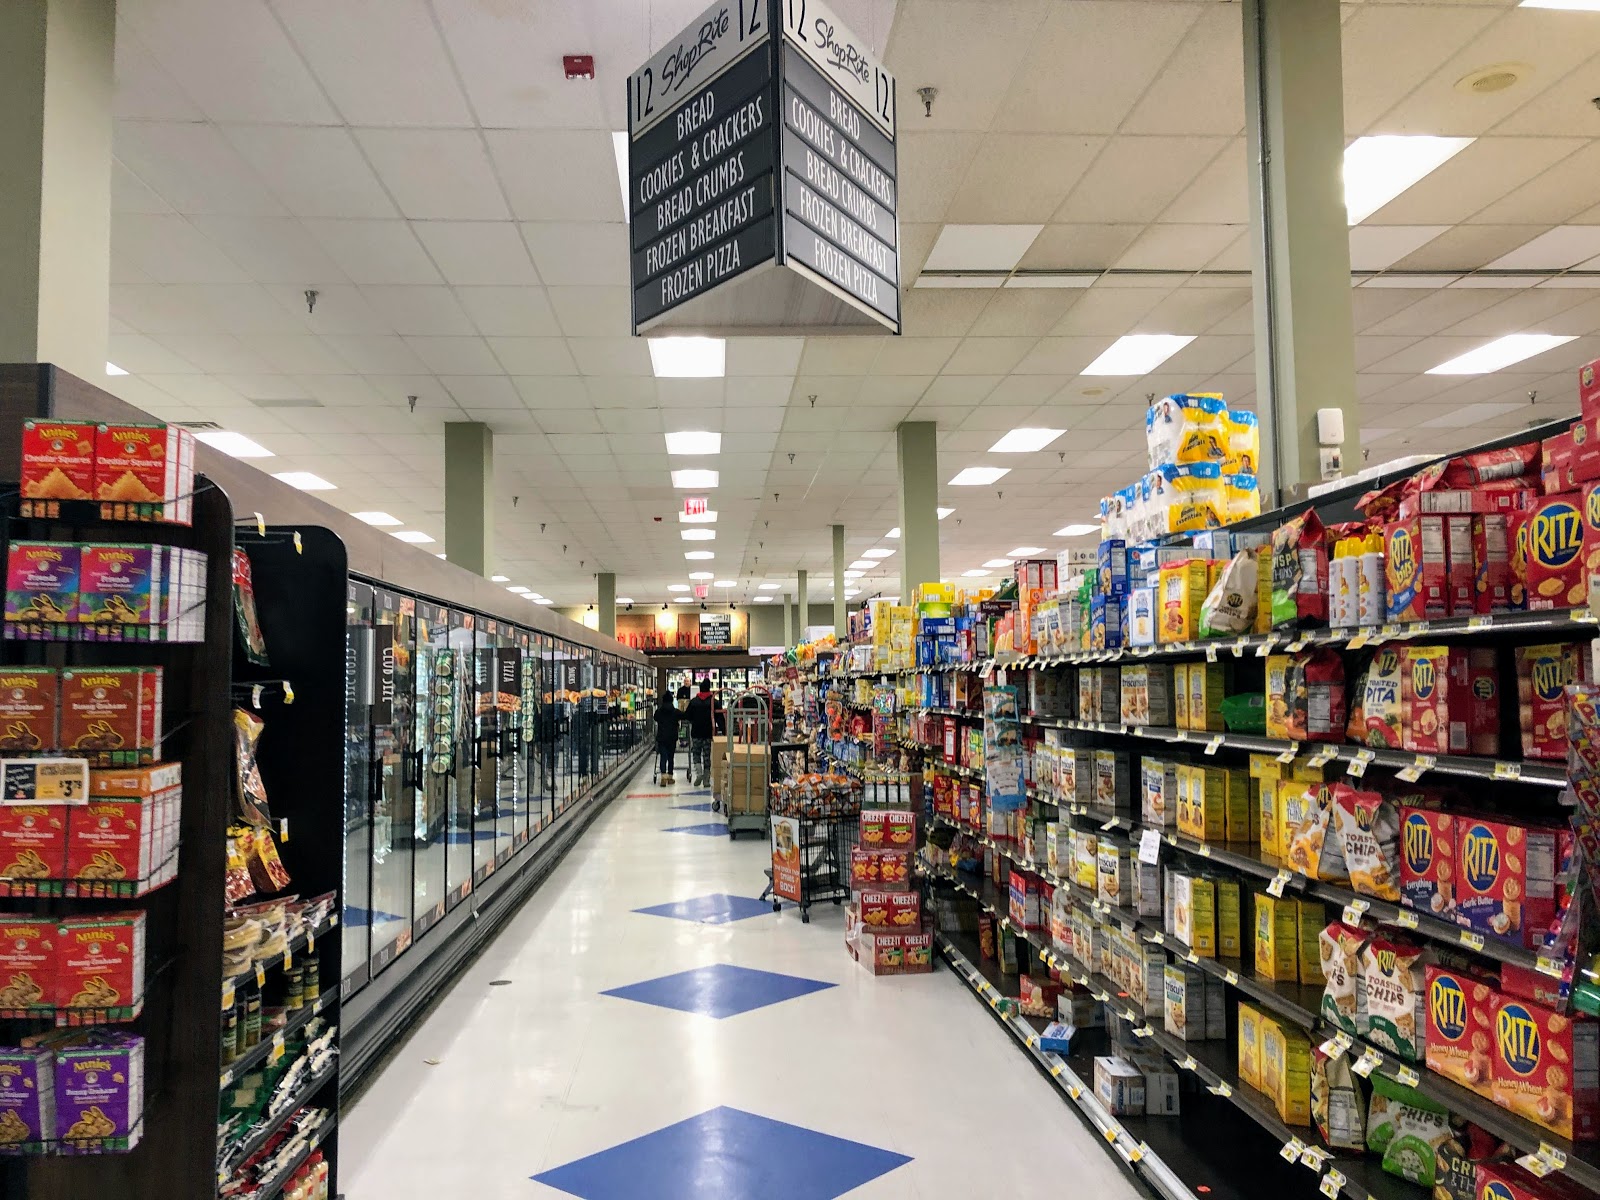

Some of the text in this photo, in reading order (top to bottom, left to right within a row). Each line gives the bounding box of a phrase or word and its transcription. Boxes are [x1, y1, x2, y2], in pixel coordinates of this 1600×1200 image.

[637, 0, 761, 122] 12 ShopRite 12
[788, 0, 890, 123] 12 ShopRite 12
[677, 91, 715, 141] BREAD
[829, 91, 860, 140] BREAD
[640, 95, 763, 203] COOKIES & CRACKERS
[792, 97, 891, 205] COOKIES & CRACKERS
[657, 152, 744, 231] BREAD CRUMBS
[806, 152, 877, 229] BREAD CRUMBS
[646, 187, 755, 275] FROZEN BREAKFAST
[800, 187, 887, 274] FROZEN BREAKFAST
[661, 240, 740, 305] FROZEN PIZZA
[815, 238, 878, 305] FROZEN PIZZA
[685, 499, 706, 515] EXIT
[1532, 511, 1582, 563] RITZ
[1392, 534, 1412, 568] RITZ
[617, 631, 666, 650] ROZEN
[503, 660, 515, 683] PIZZA
[1413, 663, 1434, 693] RITZ
[1535, 661, 1564, 695] RITZ
[1366, 687, 1396, 704] PITA
[1369, 680, 1398, 688] TOASTED
[862, 813, 885, 823] CHEEZ-IT
[889, 813, 913, 823] CHEEZ-IT
[1346, 833, 1375, 843] TOAST
[1346, 842, 1376, 856] CHIP
[1404, 821, 1431, 865] RITZ
[1464, 832, 1498, 881] RITZ
[1406, 878, 1433, 891] Everything
[863, 894, 887, 904] CHEEZ-IT
[892, 895, 917, 905] CHEEZ-IT
[1463, 896, 1494, 908] Garlic Butter
[877, 936, 901, 946] CHEEZ-IT
[905, 935, 929, 945] CHEEZ-IT
[1377, 949, 1396, 973] RITZ
[1366, 984, 1405, 1006] CHIPS
[1431, 981, 1465, 1029] RITZ
[1498, 1010, 1538, 1062] RITZ
[1430, 1043, 1469, 1059] Honey Wheat
[1498, 1077, 1543, 1096] Honey Wheat
[1400, 1105, 1444, 1128] CHIPS
[1452, 1157, 1476, 1178] CRI
